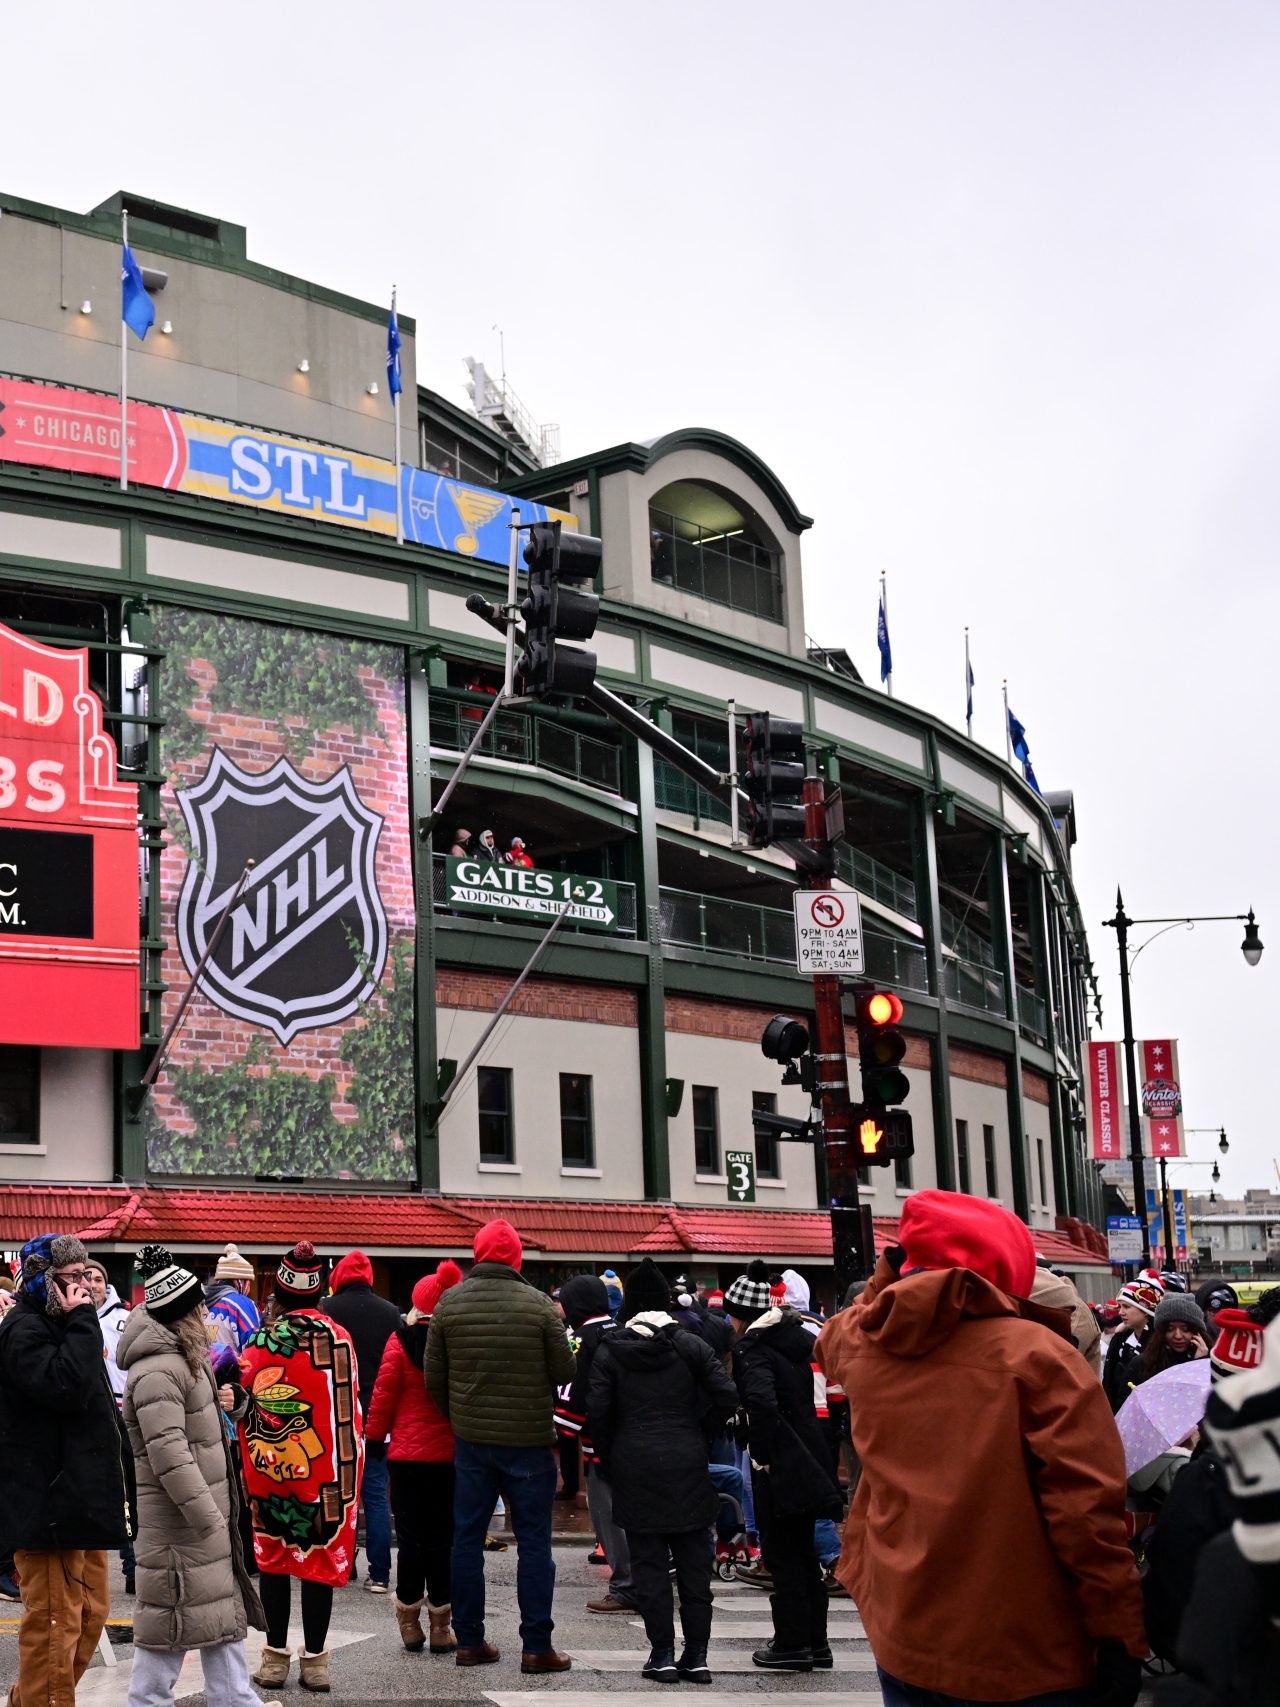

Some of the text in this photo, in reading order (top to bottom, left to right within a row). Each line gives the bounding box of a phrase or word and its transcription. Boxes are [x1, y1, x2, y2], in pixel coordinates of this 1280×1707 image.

[34, 415, 121, 449] CHICAGO
[231, 439, 365, 516] STL
[456, 862, 554, 896] GATES
[229, 834, 347, 971] NHL
[457, 890, 521, 908] ADDISON
[525, 899, 535, 910] &
[811, 940, 825, 948] FRI
[832, 940, 848, 948] SAT
[824, 930, 834, 938] TO
[826, 950, 836, 959] TO
[1098, 1047, 1112, 1153] WINTER CLASSIC
[1141, 1088, 1182, 1102] Winter
[727, 1152, 752, 1164] GATE
[732, 1163, 751, 1192] 3
[1173, 1201, 1187, 1236] STL
[166, 1271, 188, 1290] NHL
